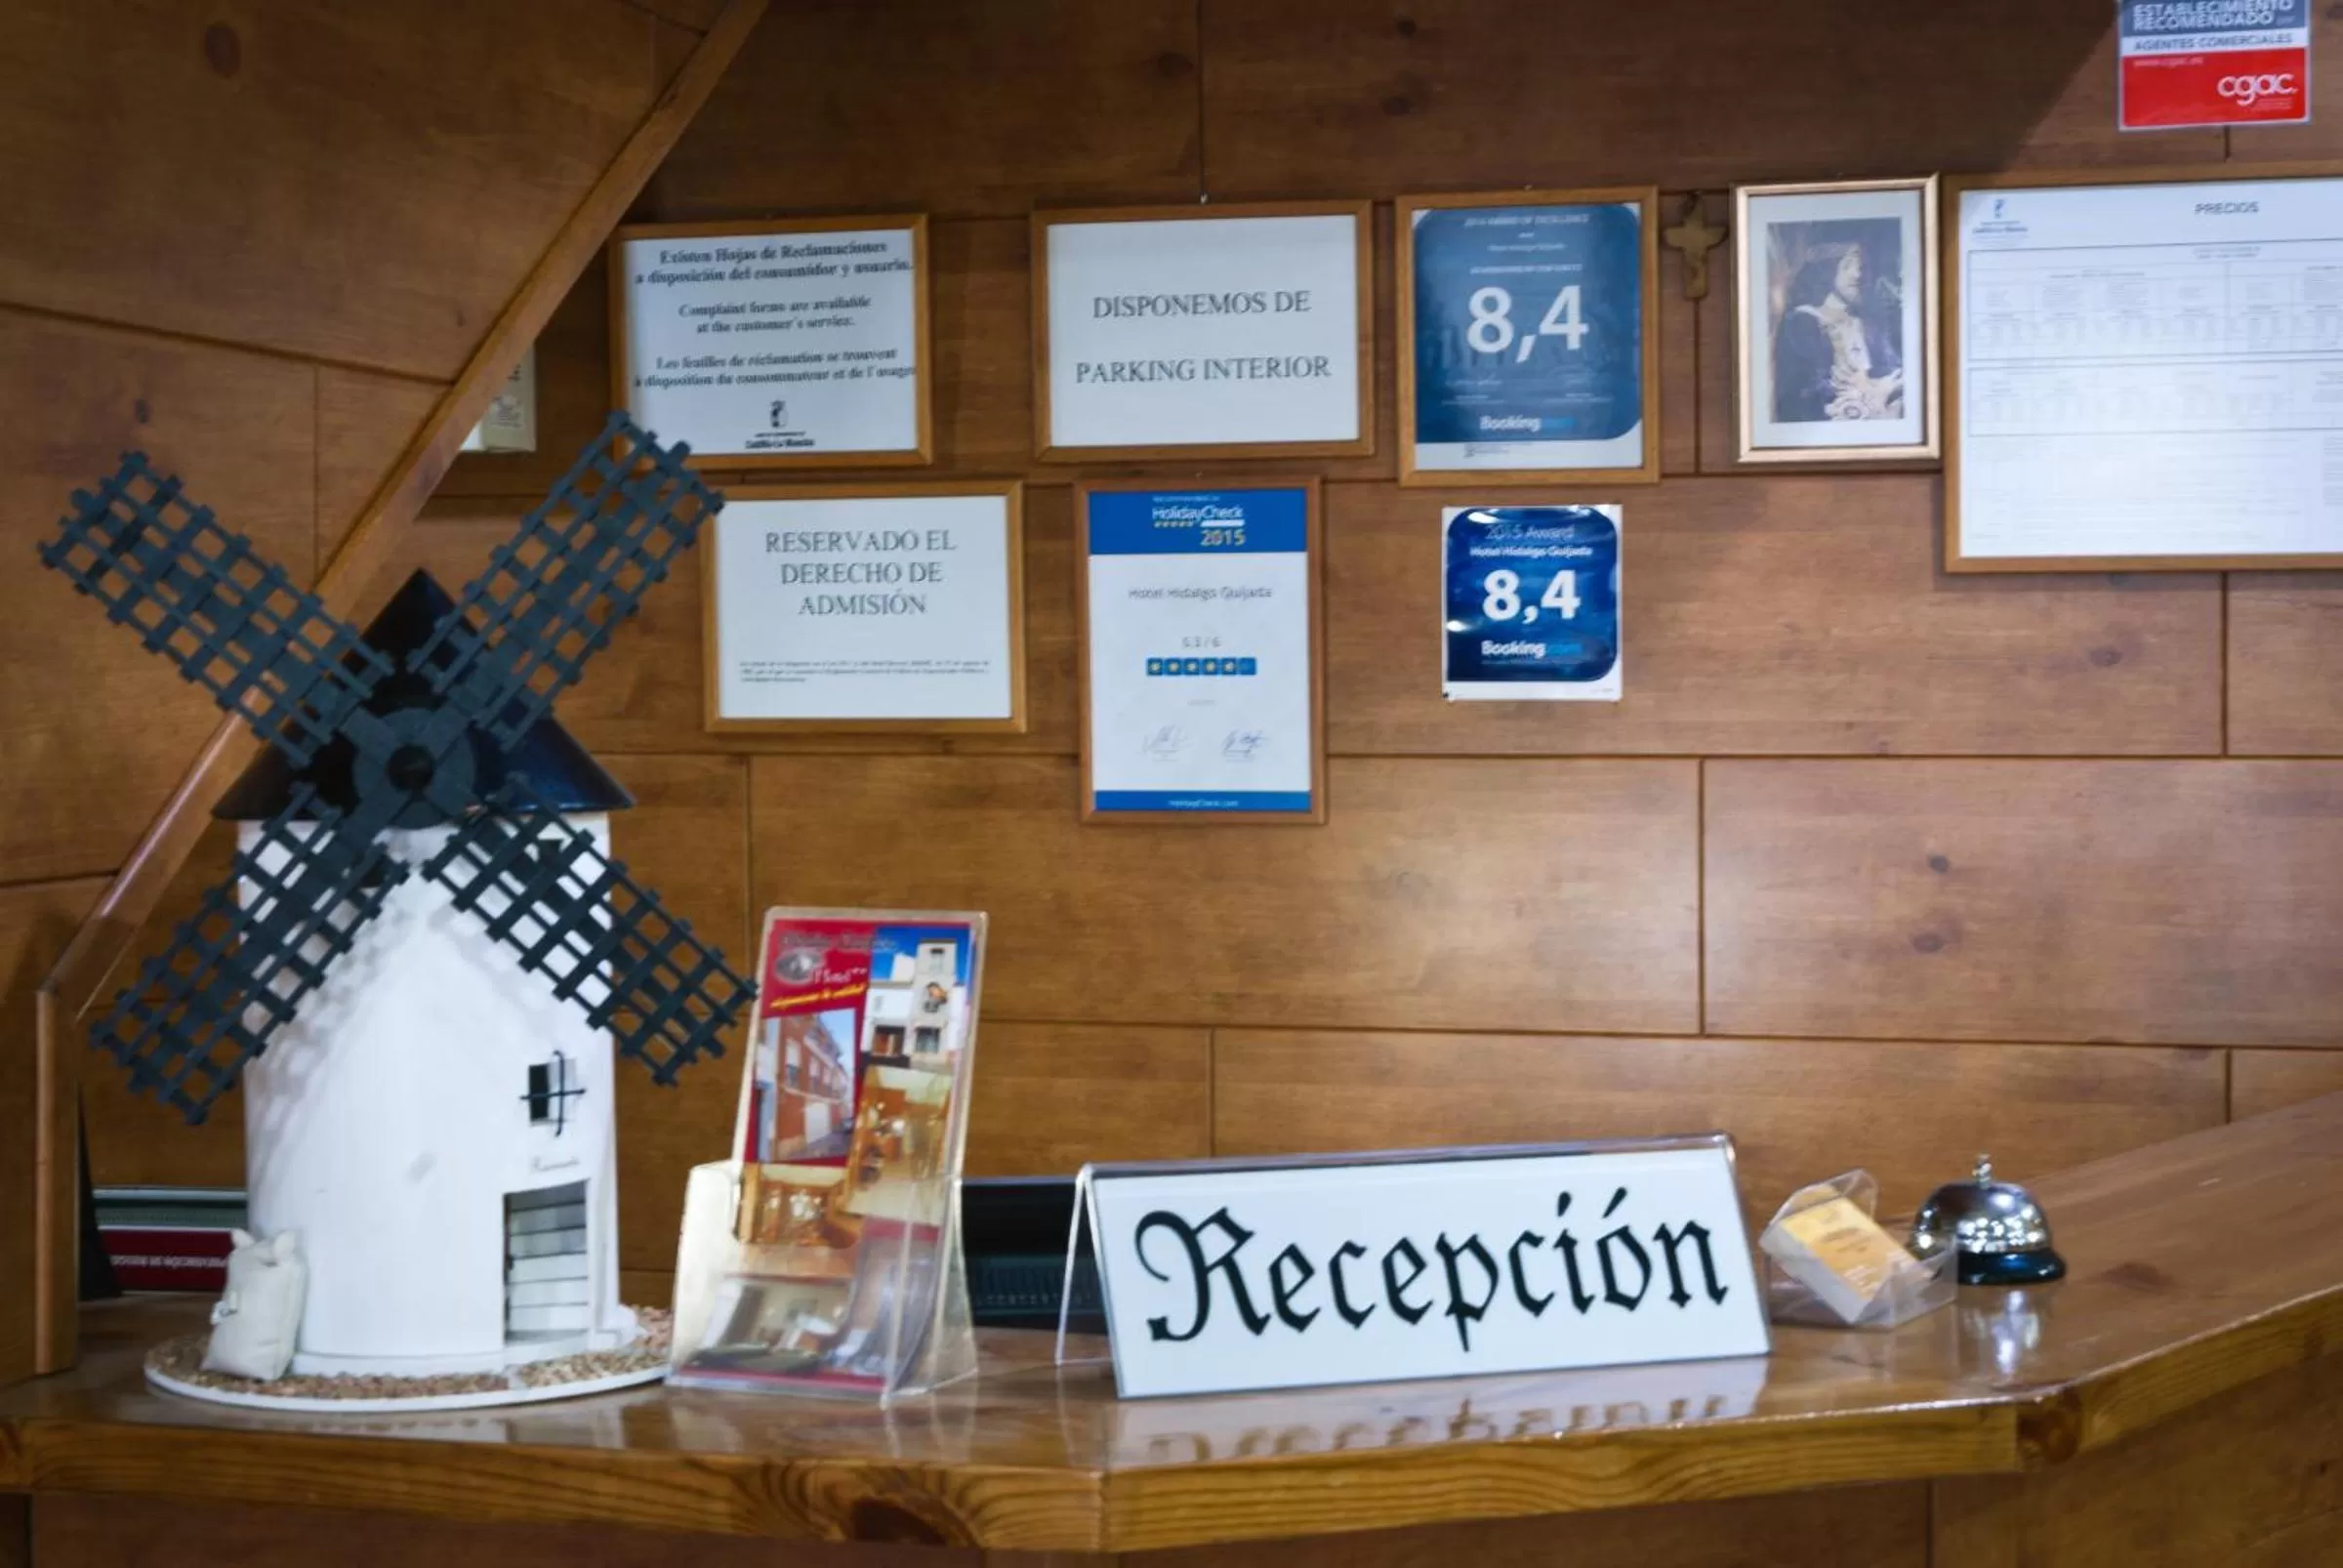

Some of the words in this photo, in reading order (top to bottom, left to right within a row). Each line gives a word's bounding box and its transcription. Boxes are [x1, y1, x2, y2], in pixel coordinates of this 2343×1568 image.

[2133, 12, 2276, 30] RECOMENDADO
[2194, 201, 2260, 216] PRECIOS
[1092, 291, 1267, 318] DISPONEMOS
[1272, 290, 1313, 312] DE
[1466, 284, 1590, 363] 8,4
[1075, 359, 1196, 384] PARKING
[1203, 355, 1333, 380] INTERIOR
[1152, 504, 1244, 521] HolidayCheck
[764, 529, 920, 554] RESERVADO
[925, 528, 958, 551] EL
[1200, 528, 1247, 546] 2015
[780, 561, 903, 586] DERECHO
[909, 560, 943, 583] DE
[798, 588, 928, 616] ADMISIÓN
[1482, 569, 1582, 625] 8,4
[1133, 1186, 1729, 1354] Recepción
